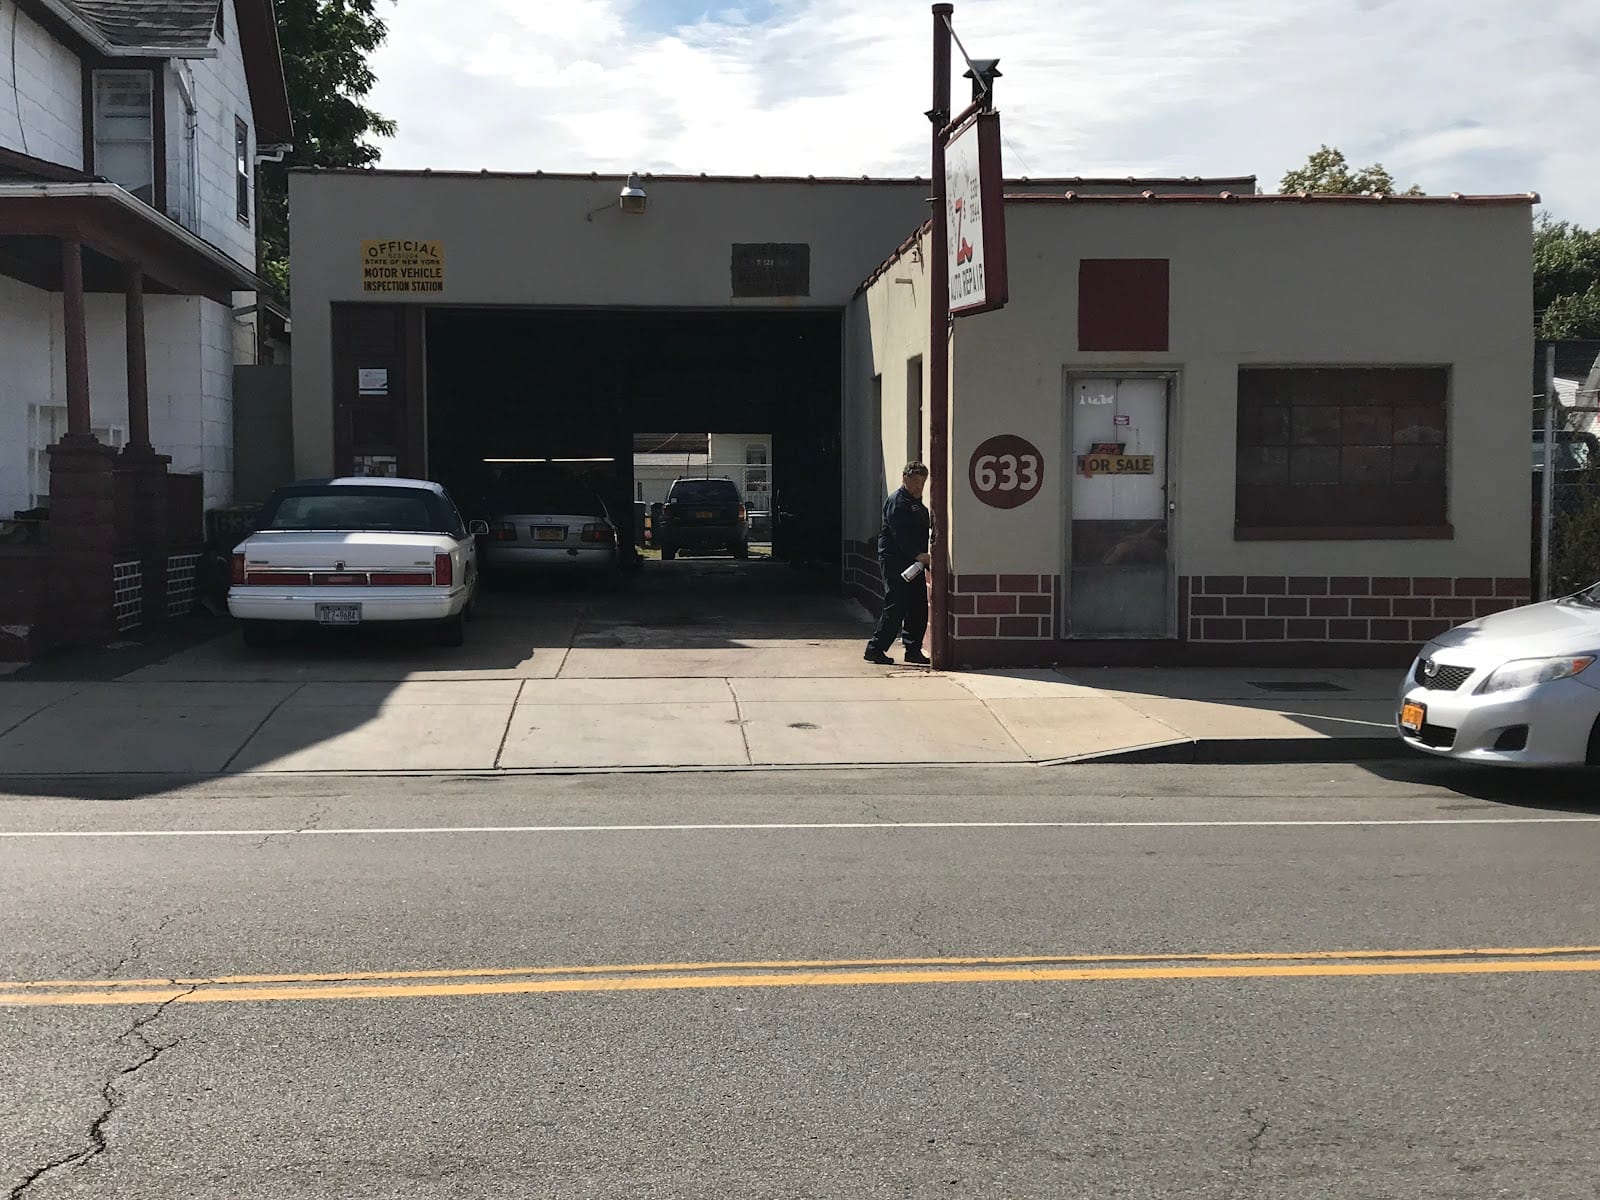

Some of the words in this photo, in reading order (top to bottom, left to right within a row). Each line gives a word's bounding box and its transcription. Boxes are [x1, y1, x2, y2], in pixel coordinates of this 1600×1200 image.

[368, 241, 438, 257] OFFICIAL
[364, 267, 398, 278] MOTOR
[400, 267, 442, 278] VEHICLE
[363, 281, 410, 291] INSPECTION
[411, 281, 443, 291] STATION
[962, 263, 984, 297] REPAIR
[1116, 459, 1151, 471] SALE
[974, 454, 1039, 492] 633
